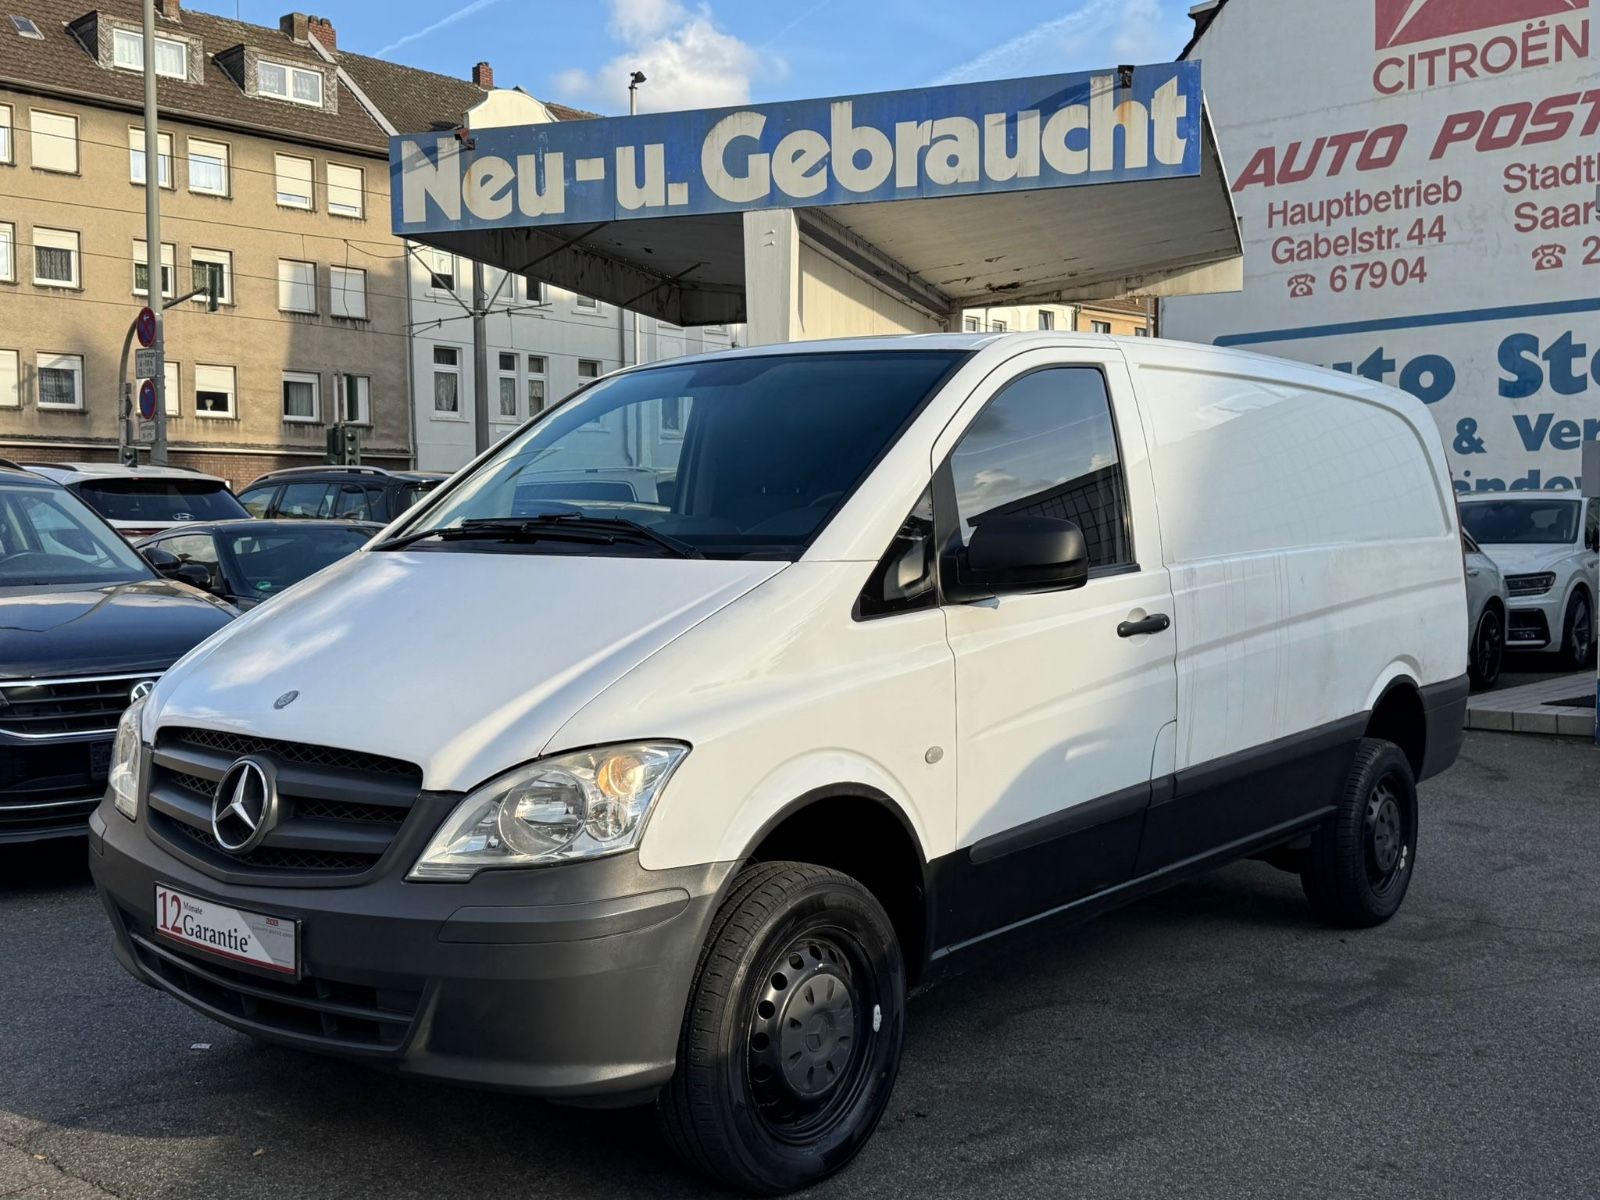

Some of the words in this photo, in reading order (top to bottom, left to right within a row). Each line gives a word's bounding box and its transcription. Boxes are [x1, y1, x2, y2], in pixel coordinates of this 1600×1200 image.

[1373, 19, 1590, 94] CITROËN
[701, 75, 1187, 203] Gebraucht
[1231, 123, 1408, 193] AUTO
[1503, 152, 1600, 194] Stadt
[1267, 175, 1462, 228] Hauptbetrieb
[1514, 201, 1600, 233] Saar
[1271, 226, 1401, 265] Gabelstr.
[1406, 214, 1447, 246] 44
[1329, 256, 1427, 293] 67904
[1498, 330, 1600, 398] St
[1453, 417, 1487, 455] &
[158, 891, 183, 935] 12
[183, 914, 249, 953] Garantie
